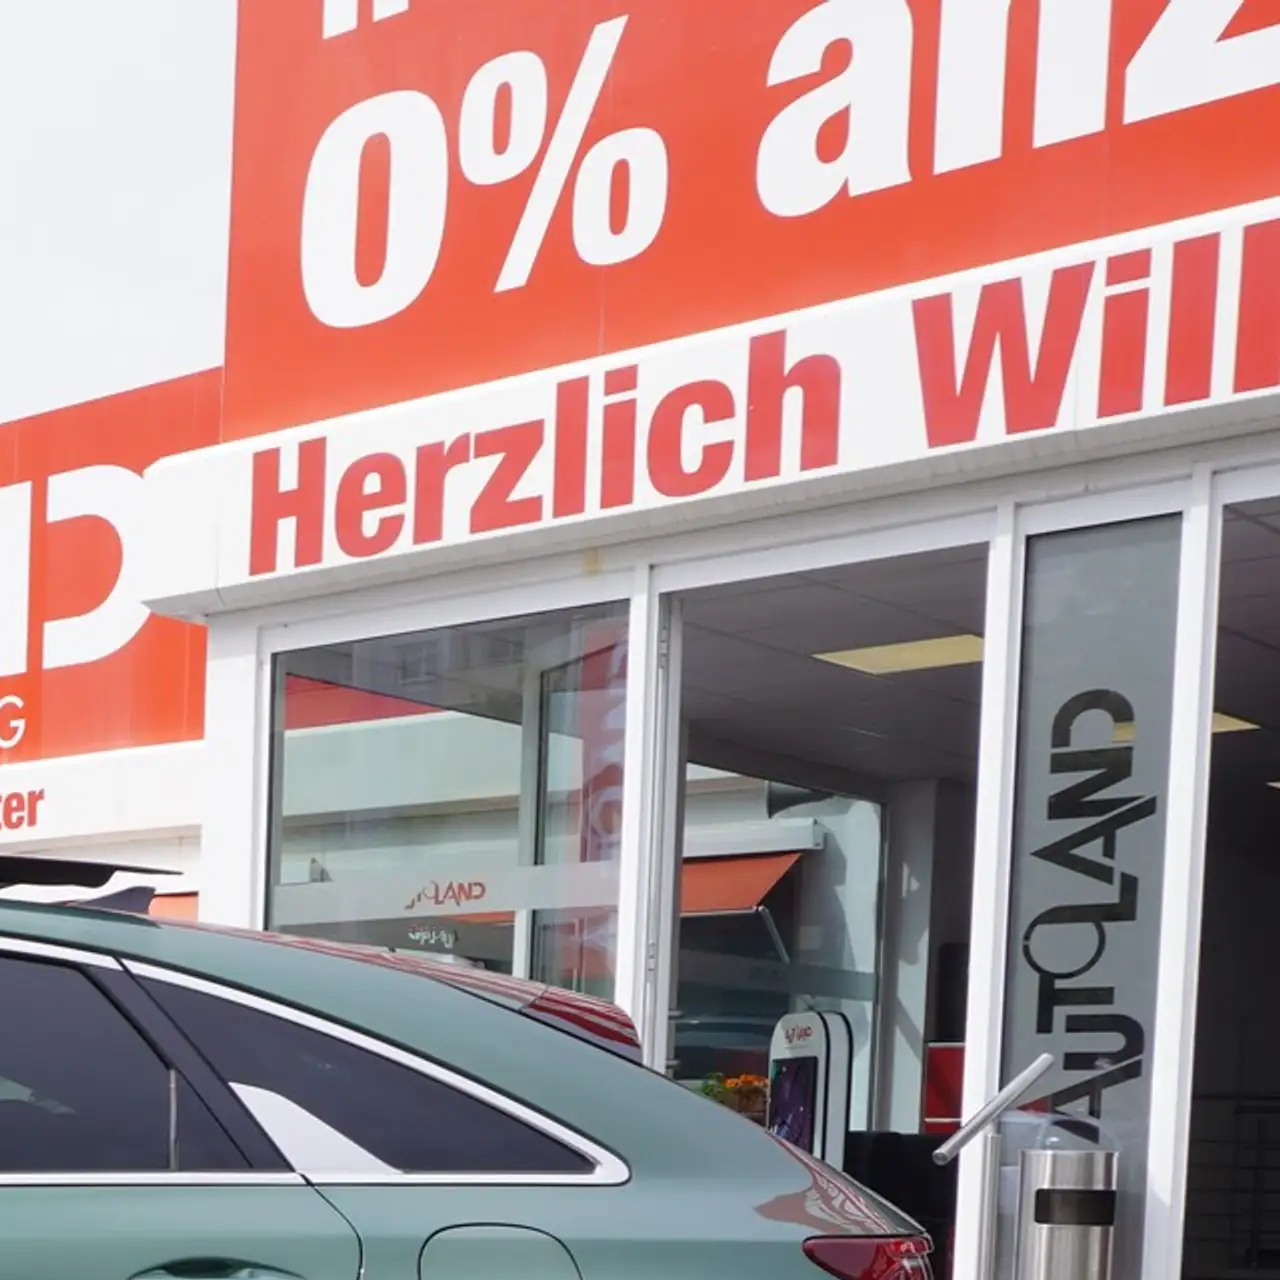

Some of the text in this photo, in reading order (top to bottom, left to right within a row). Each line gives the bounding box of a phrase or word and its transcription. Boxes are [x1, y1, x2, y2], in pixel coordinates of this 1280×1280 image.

[300, 14, 669, 329] 0%
[248, 217, 1280, 577] Herzlich Will
[1022, 688, 1158, 1146] AUTOLAND
